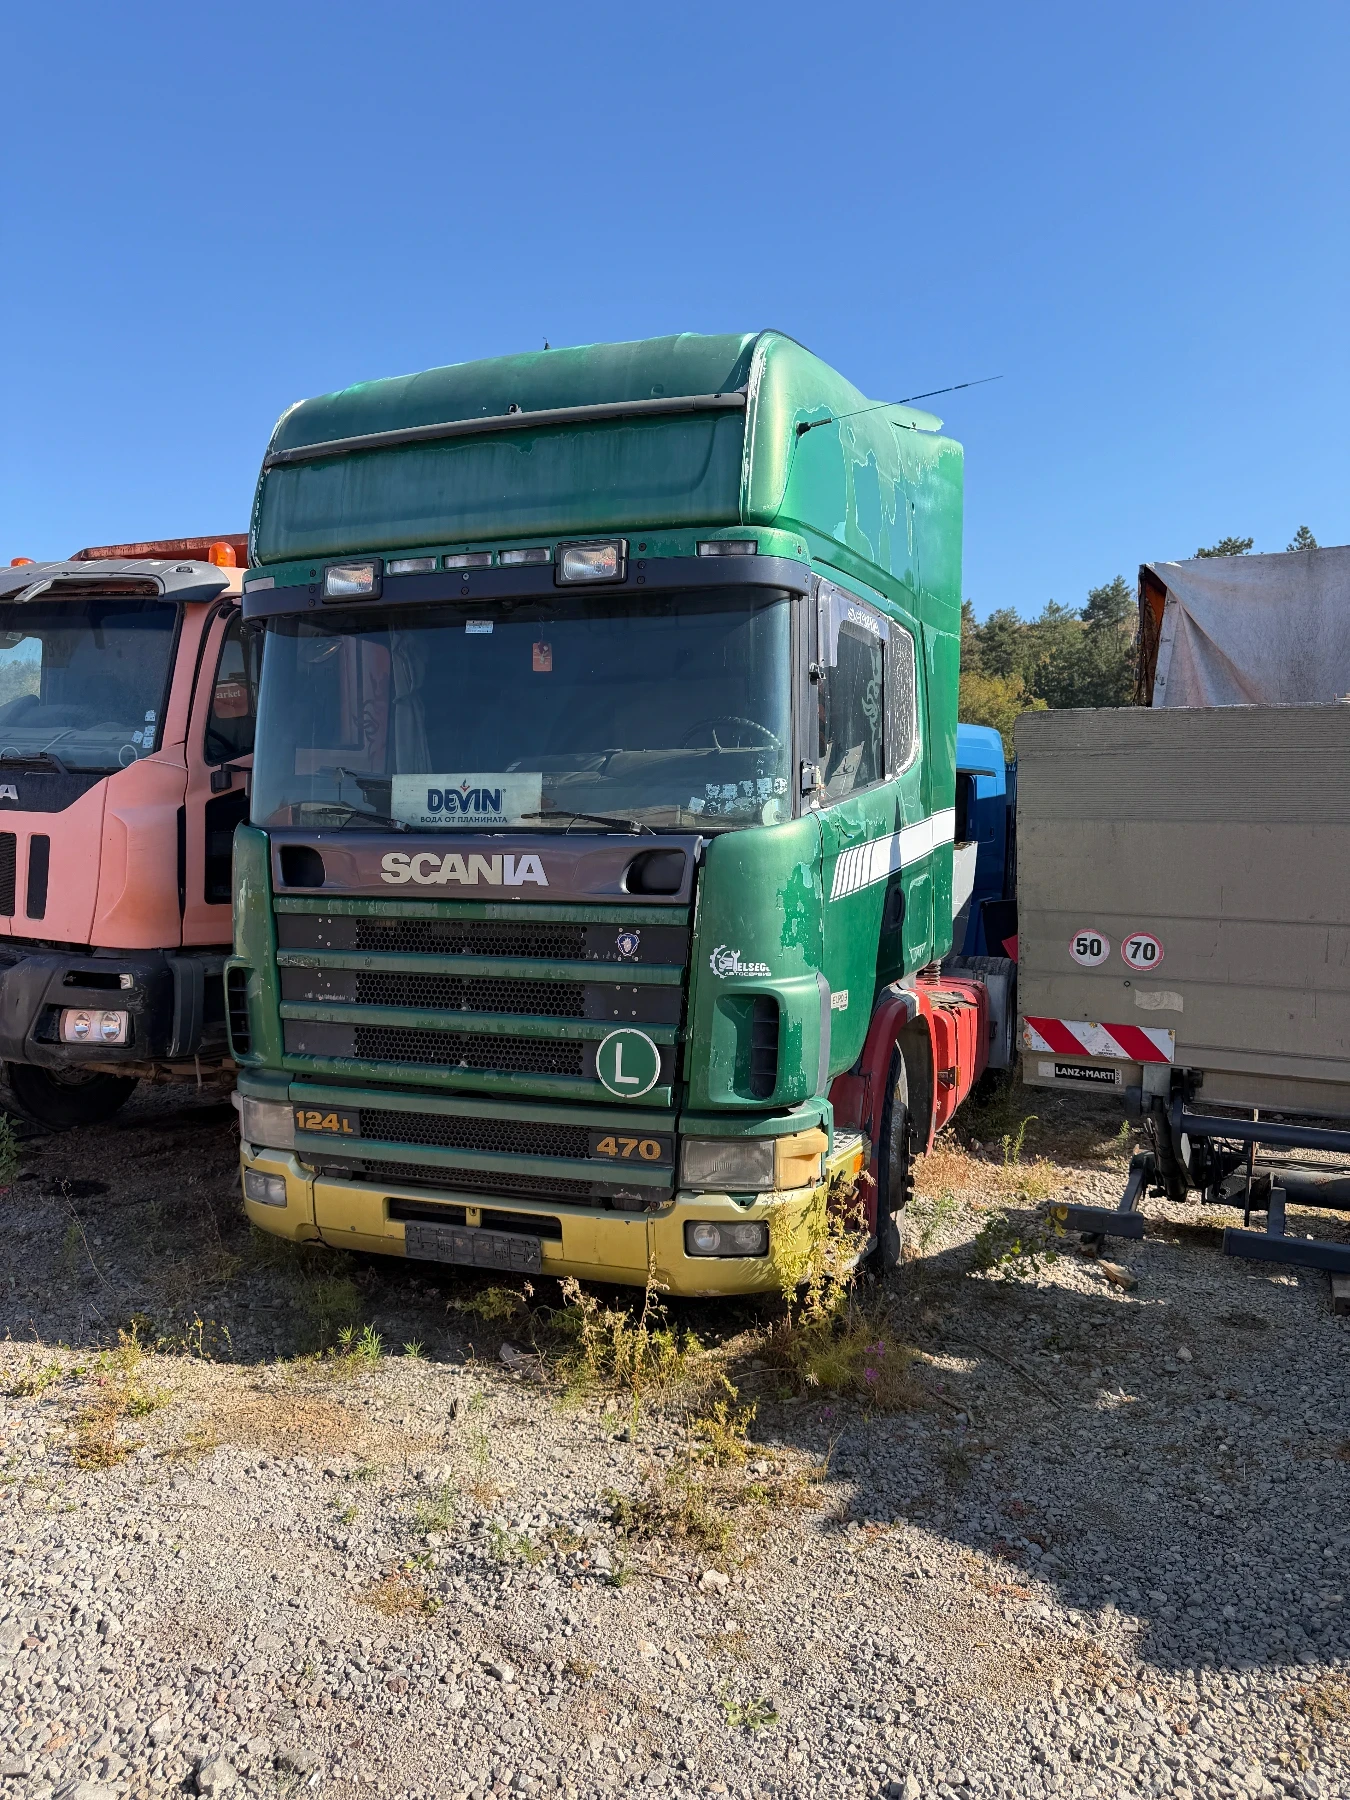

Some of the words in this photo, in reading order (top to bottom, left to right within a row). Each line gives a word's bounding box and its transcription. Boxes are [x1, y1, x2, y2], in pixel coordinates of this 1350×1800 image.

[457, 816, 508, 824] ПЛАНИНАТА
[380, 852, 550, 886] SCANIA
[1075, 937, 1102, 957] 50
[1129, 940, 1156, 961] 70
[614, 1042, 640, 1085] L
[1055, 1065, 1115, 1081] LANZ+MARTI
[596, 1136, 662, 1160] 470
